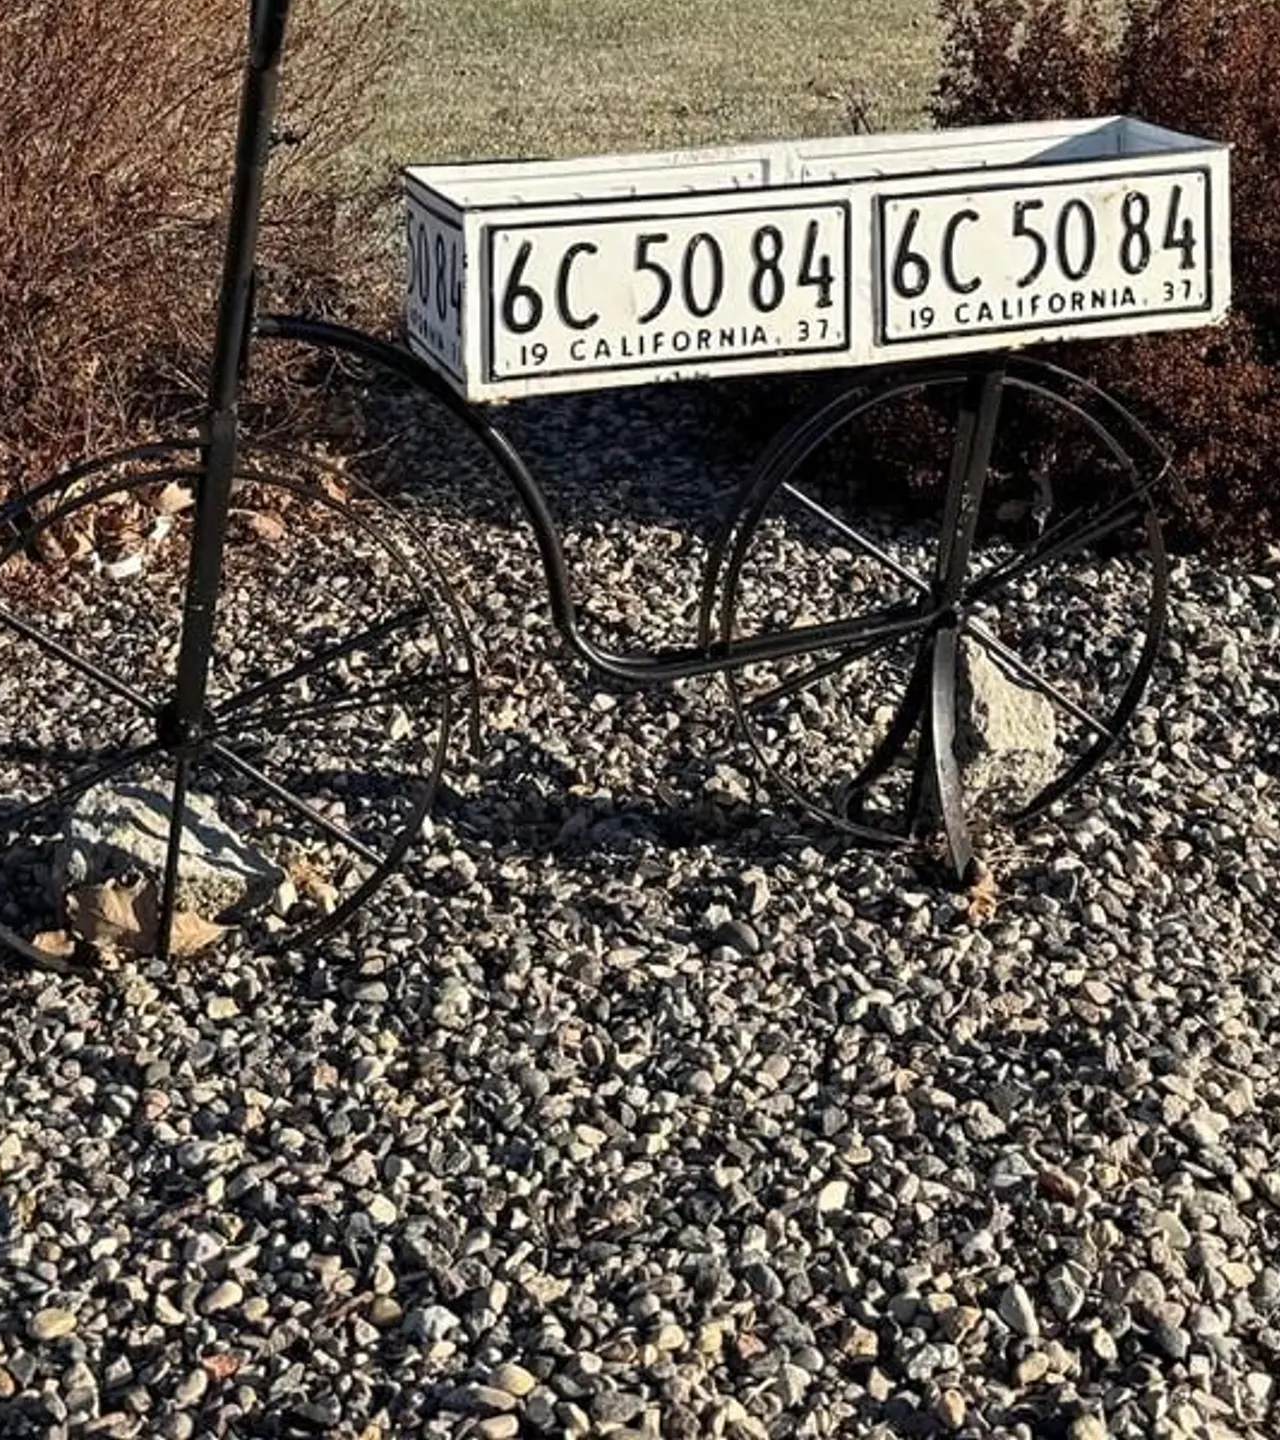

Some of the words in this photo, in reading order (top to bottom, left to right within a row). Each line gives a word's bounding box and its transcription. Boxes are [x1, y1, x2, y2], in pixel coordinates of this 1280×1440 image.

[501, 240, 599, 334] 6C
[635, 232, 724, 325] 50
[749, 219, 834, 313] 84
[892, 208, 982, 299] 6C
[1013, 199, 1096, 288] 50
[1120, 184, 1196, 275] 84
[521, 343, 548, 366] 19
[570, 324, 768, 361] CALIFORNIA
[798, 319, 829, 342] 37
[910, 307, 934, 329] 19
[954, 286, 1136, 324] CALIFORNIA
[1163, 279, 1191, 302] 37
